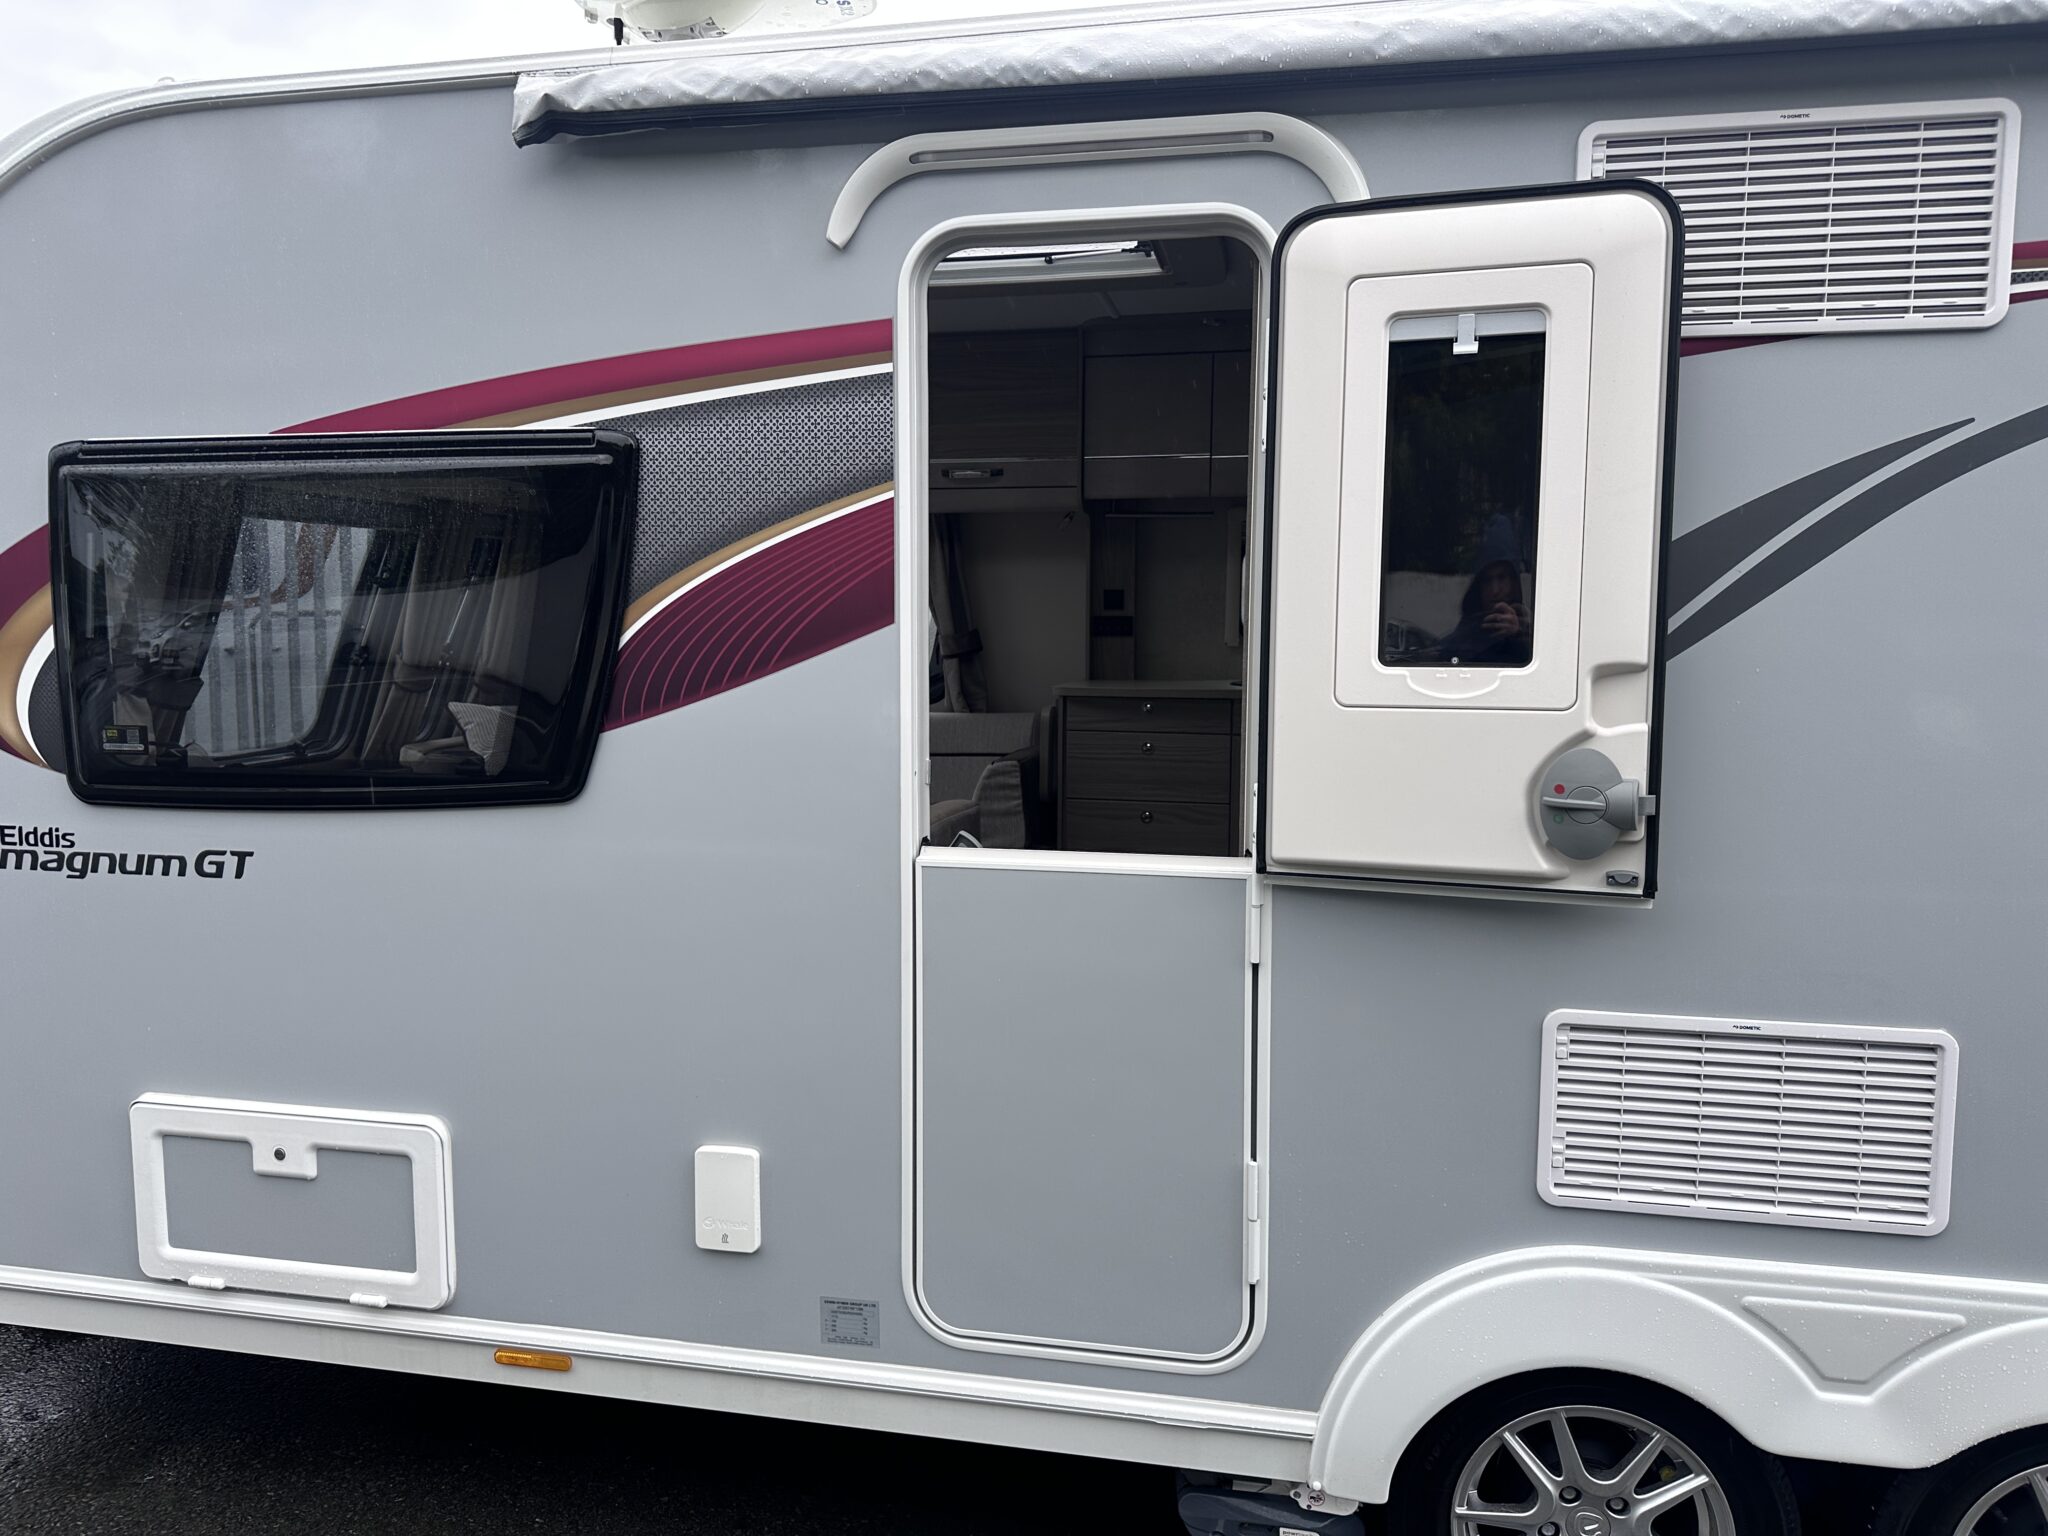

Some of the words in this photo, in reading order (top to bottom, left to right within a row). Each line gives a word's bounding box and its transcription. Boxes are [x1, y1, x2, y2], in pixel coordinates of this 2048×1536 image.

[0, 825, 76, 848] Elddis
[0, 848, 188, 879] magnum
[194, 850, 255, 879] GT
